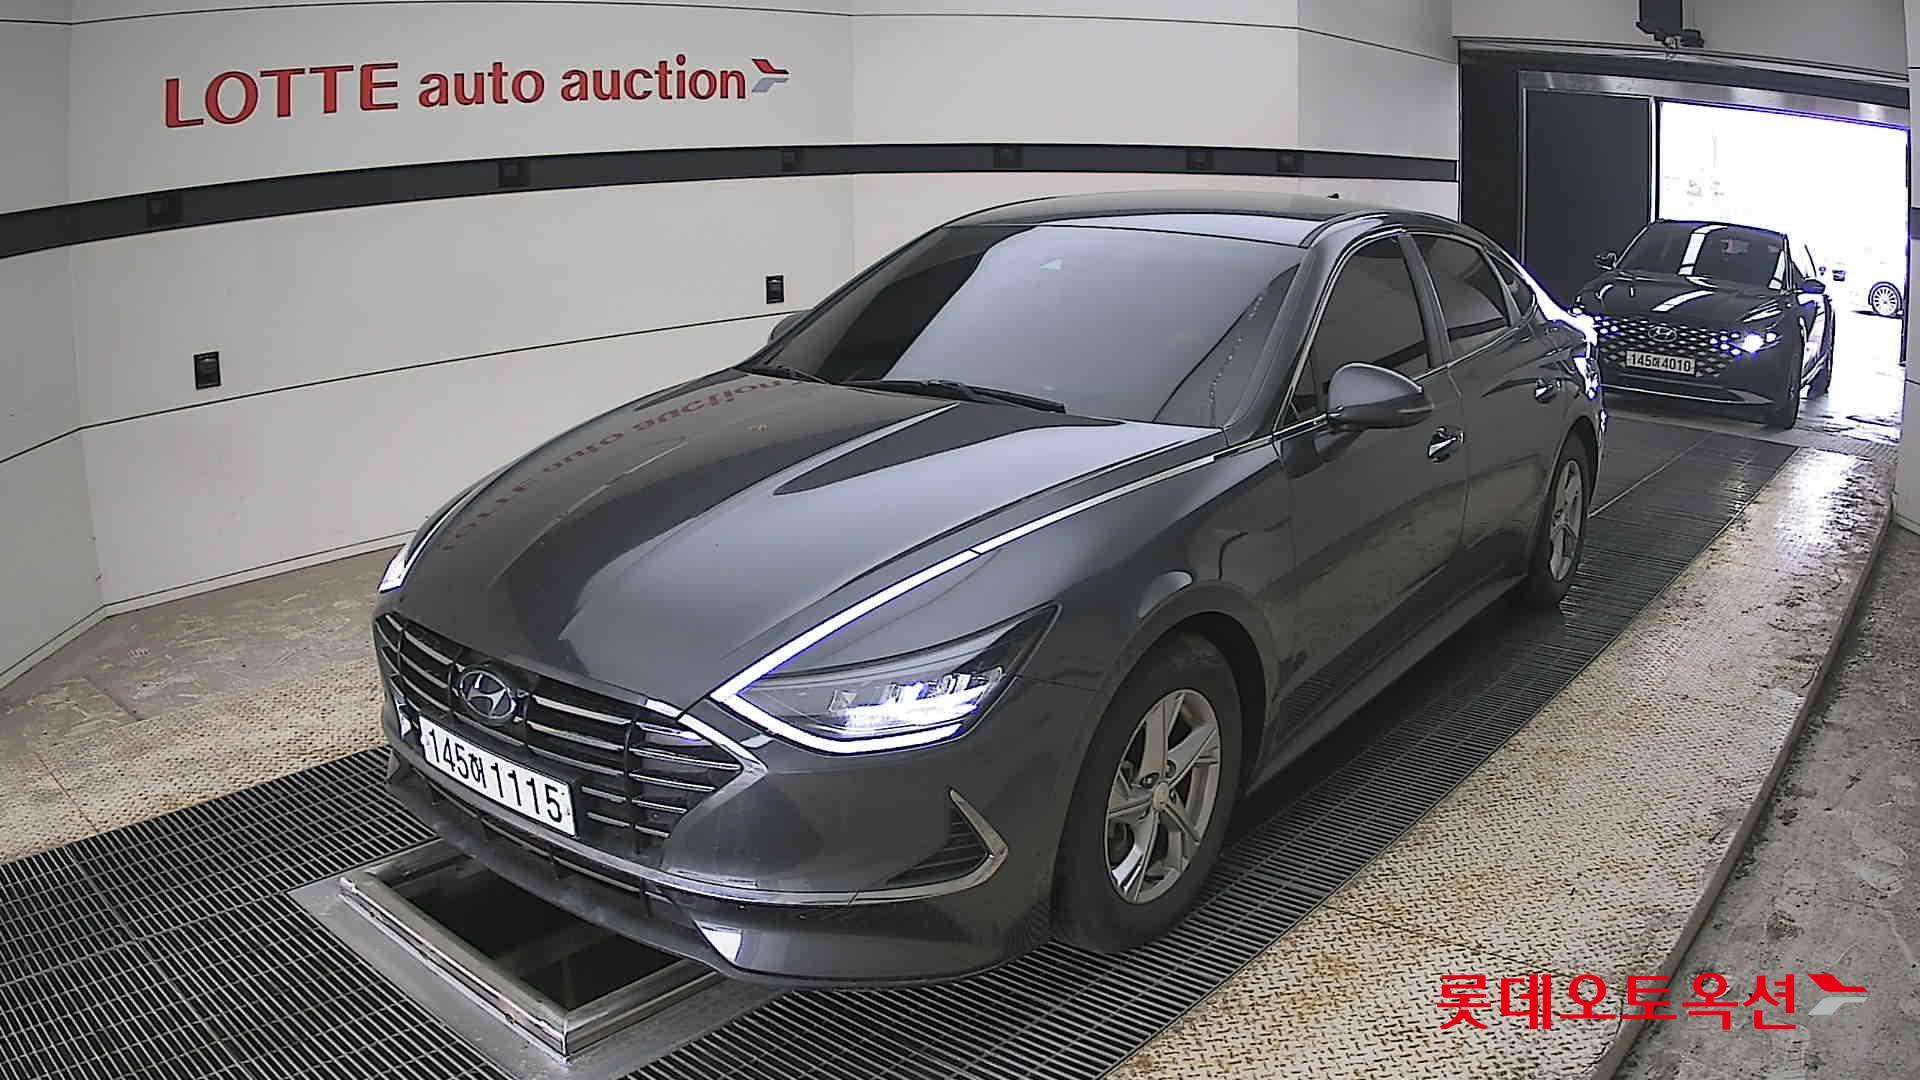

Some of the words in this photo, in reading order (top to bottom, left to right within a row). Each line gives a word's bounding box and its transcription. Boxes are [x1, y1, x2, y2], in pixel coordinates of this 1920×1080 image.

[162, 61, 400, 130] LOTTE
[417, 61, 546, 109] auto
[559, 53, 748, 103] auction
[428, 728, 563, 823] 145허1115
